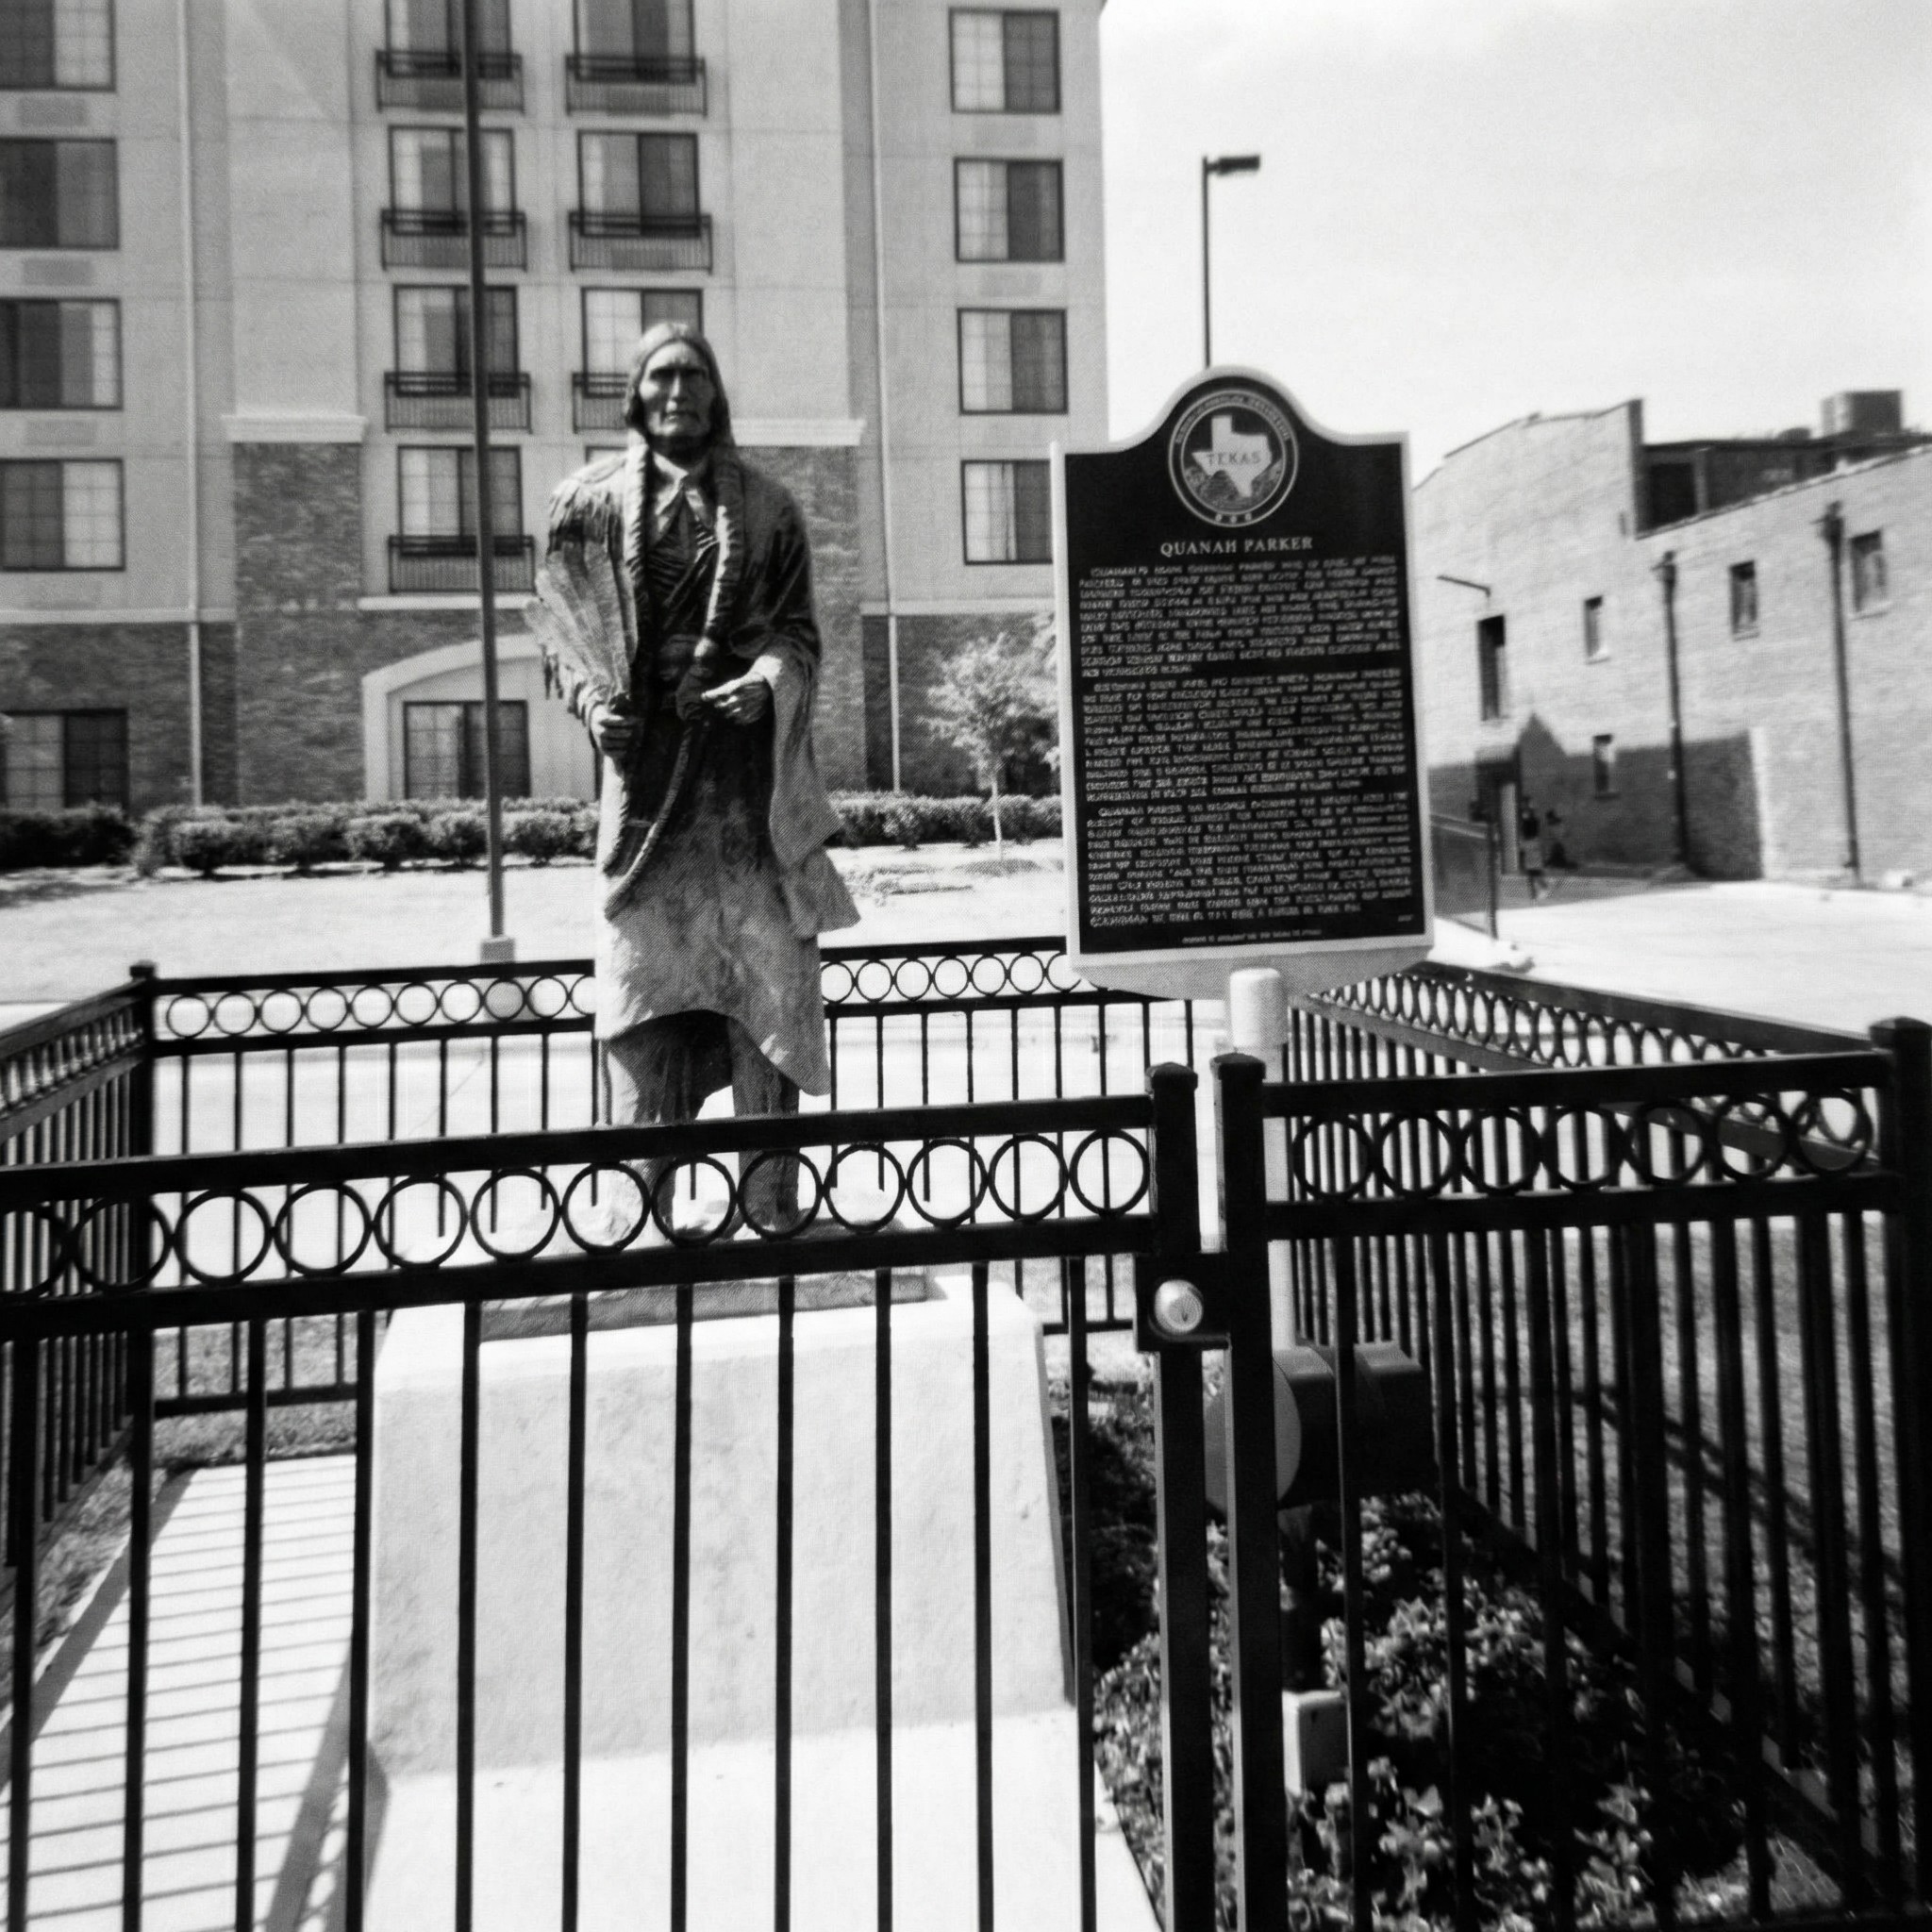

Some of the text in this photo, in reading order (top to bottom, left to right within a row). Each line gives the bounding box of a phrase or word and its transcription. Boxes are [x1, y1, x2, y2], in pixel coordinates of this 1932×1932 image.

[1207, 451, 1262, 467] TEXAS
[1160, 536, 1313, 558] QUANAH PARKER
